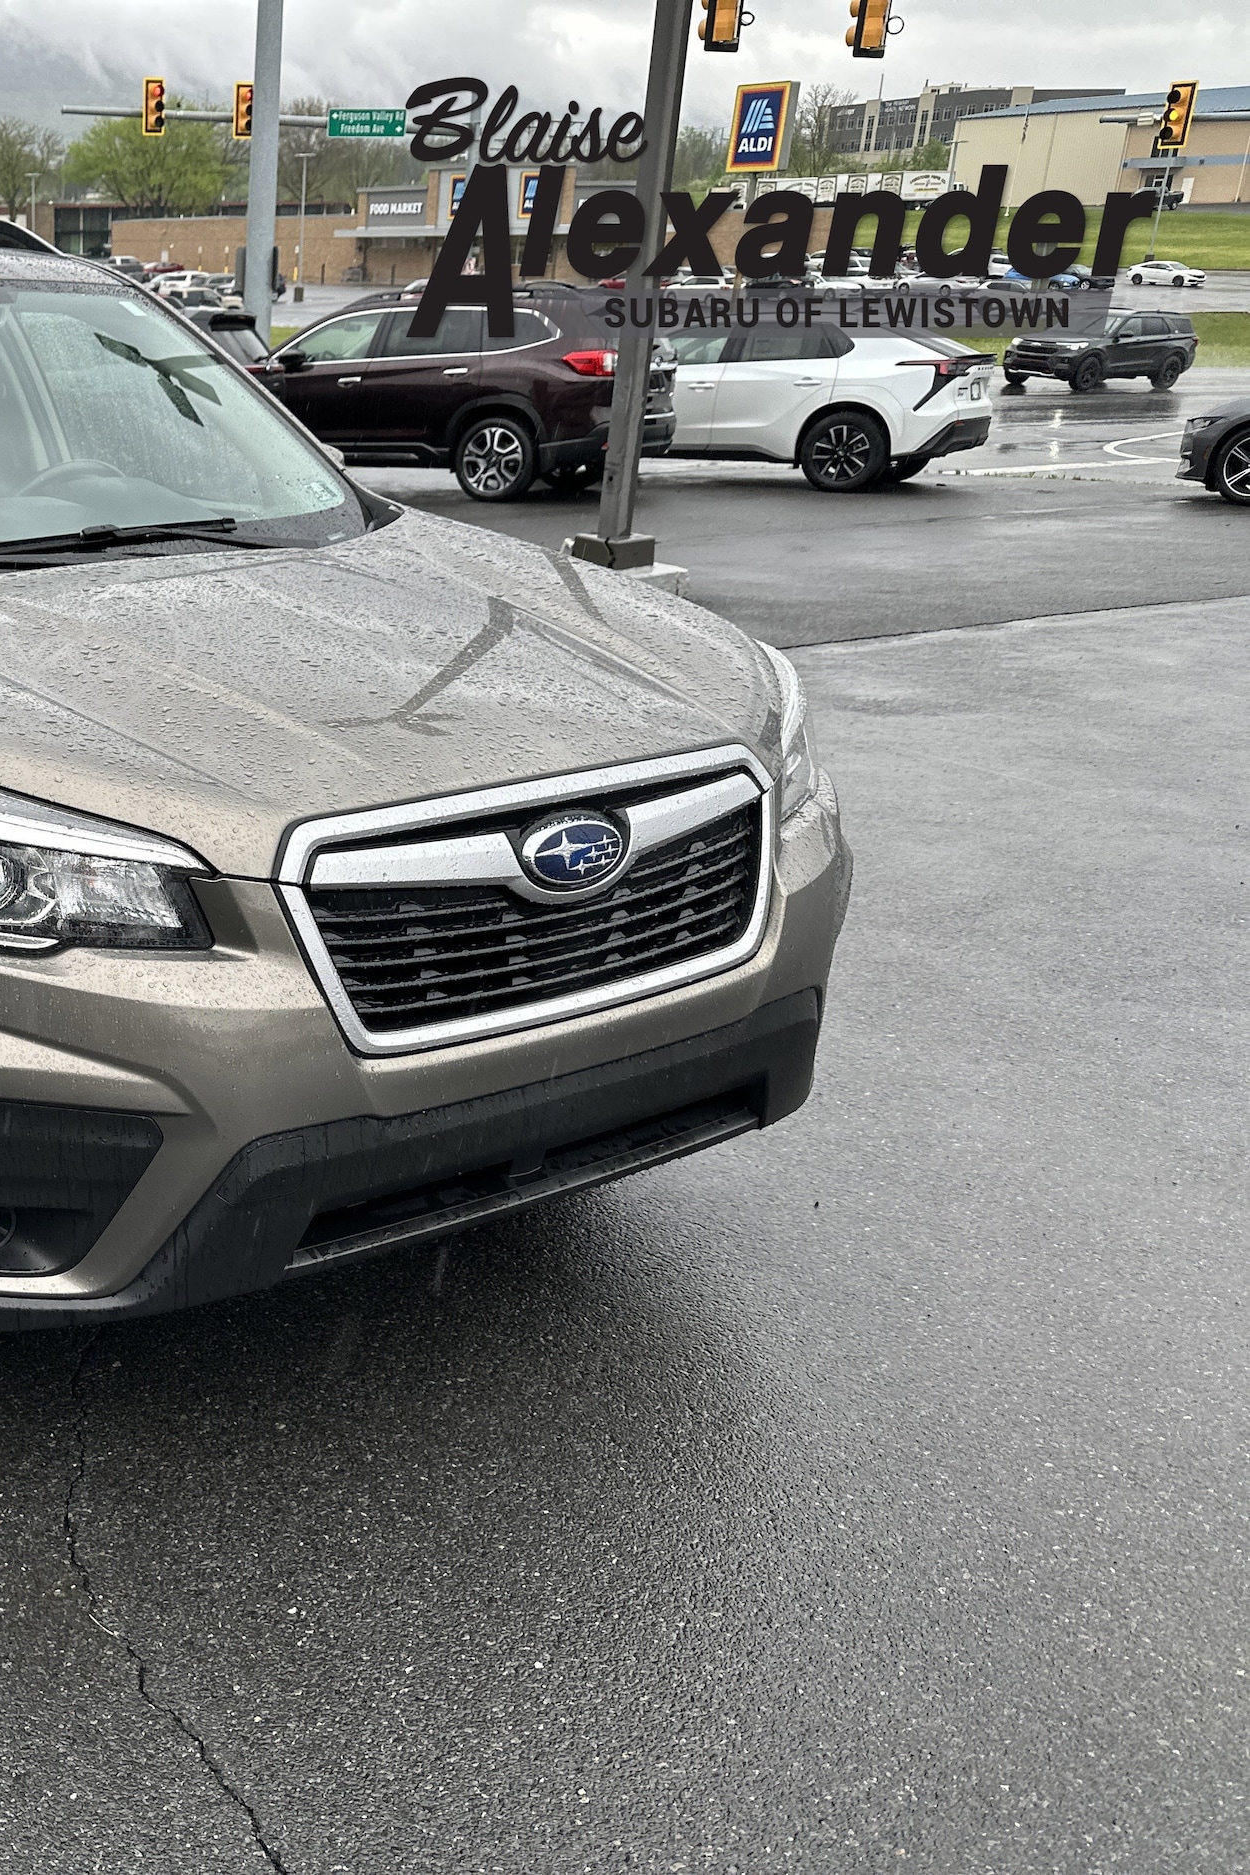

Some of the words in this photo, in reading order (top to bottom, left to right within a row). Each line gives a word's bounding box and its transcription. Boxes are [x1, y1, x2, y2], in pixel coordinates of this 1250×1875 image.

[339, 111, 370, 123] Ferguson
[372, 111, 394, 123] Valley
[395, 111, 405, 120] Rd
[340, 123, 370, 133] Freedom
[372, 124, 385, 133] Ave
[737, 136, 773, 153] ALDI
[369, 203, 389, 215] FOOD
[390, 202, 423, 214] MARKET
